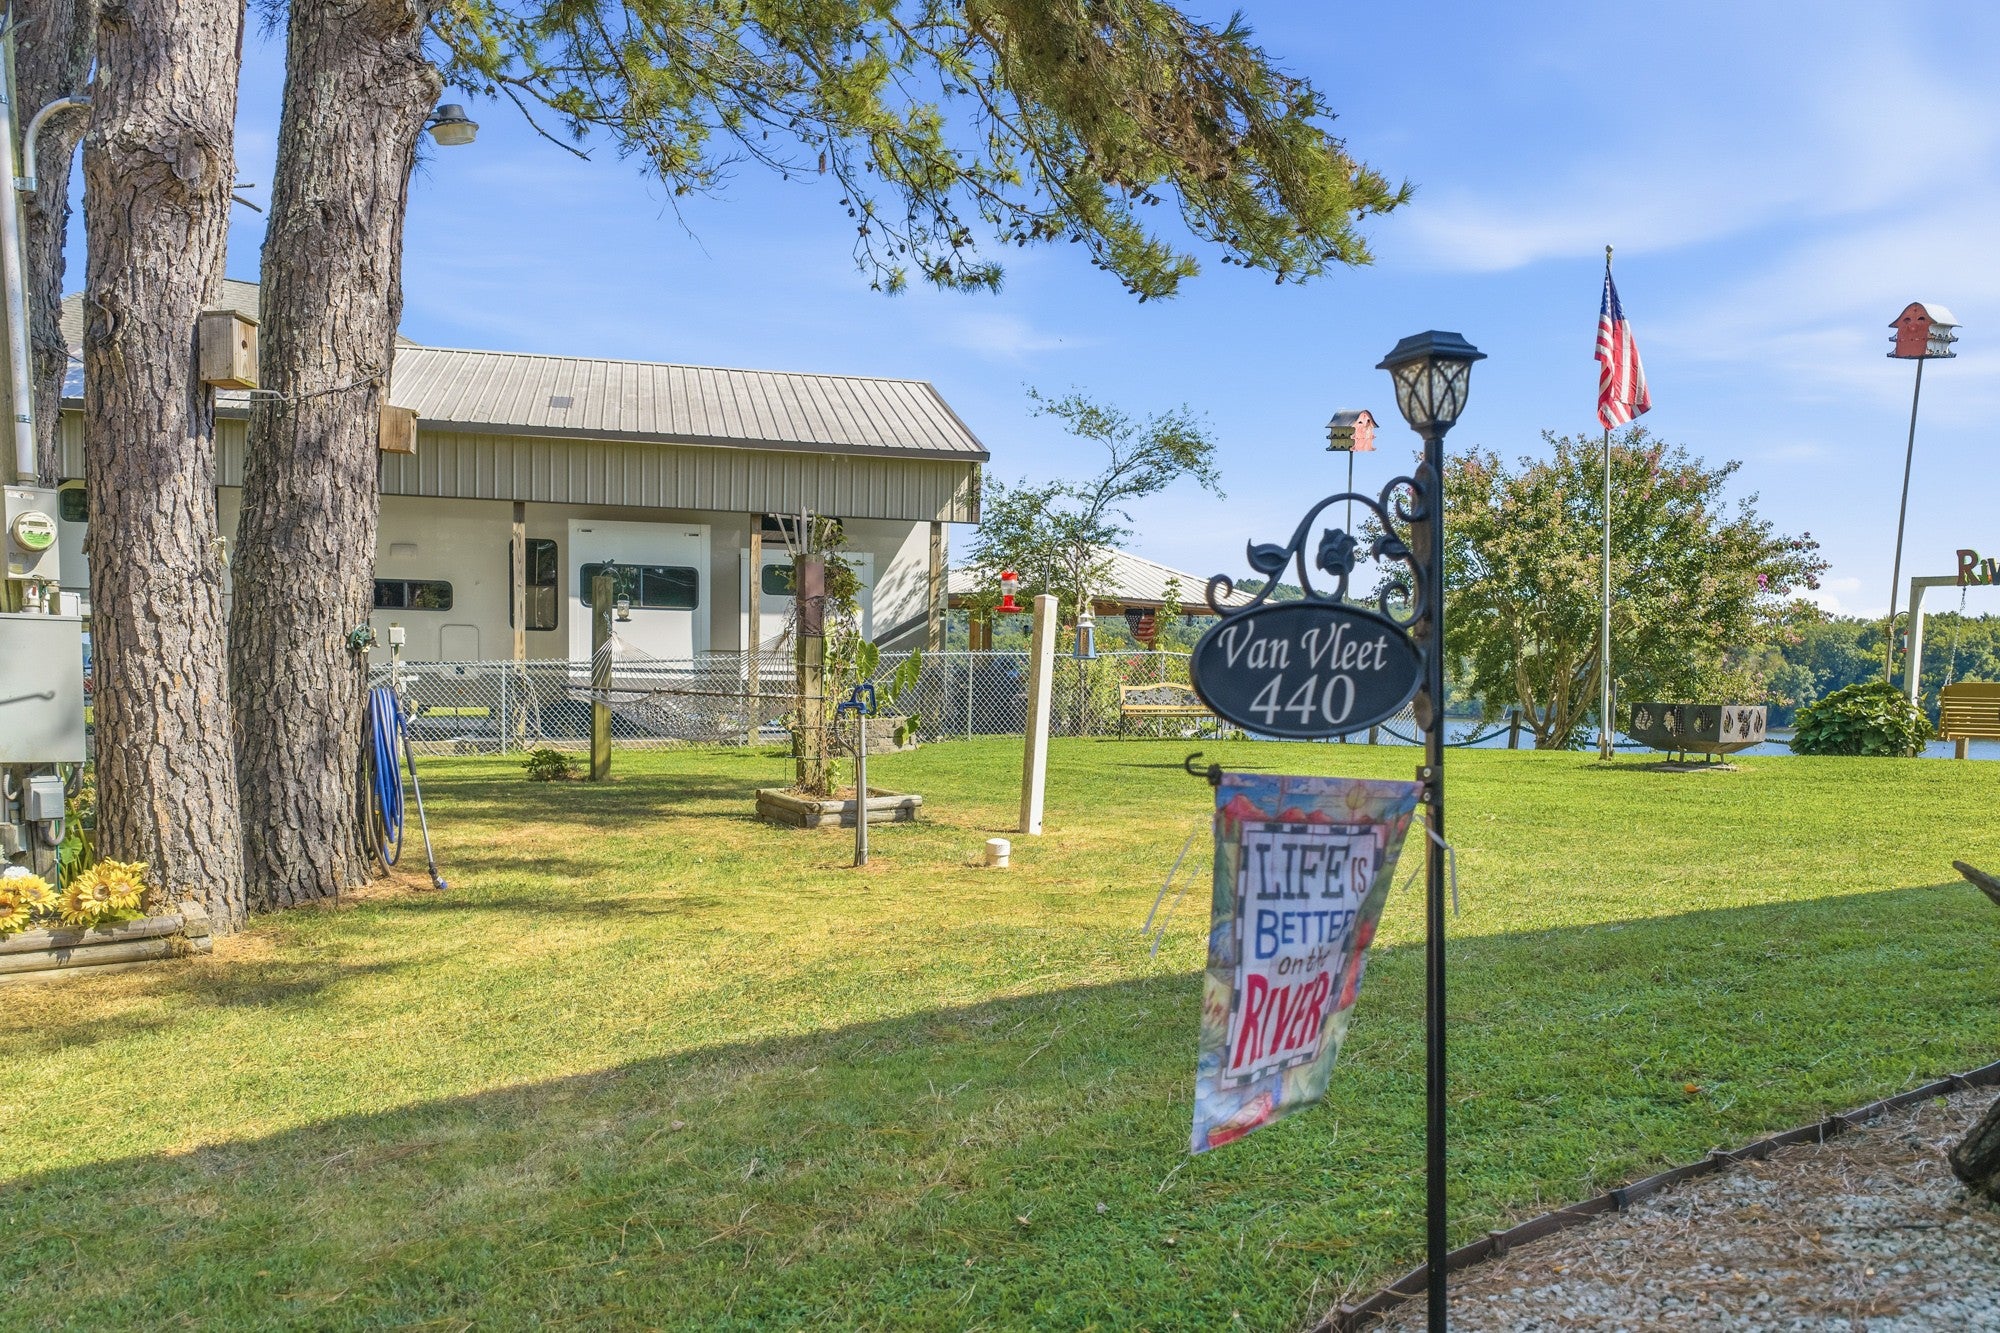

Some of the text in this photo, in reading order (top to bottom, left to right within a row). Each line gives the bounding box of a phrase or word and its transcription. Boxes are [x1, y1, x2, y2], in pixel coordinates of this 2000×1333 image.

[1218, 620, 1388, 671] Van Vleet
[1250, 673, 1355, 725] 440
[1256, 843, 1351, 899] LIFE
[1278, 956, 1302, 975] on
[1233, 973, 1330, 1069] RIVER
